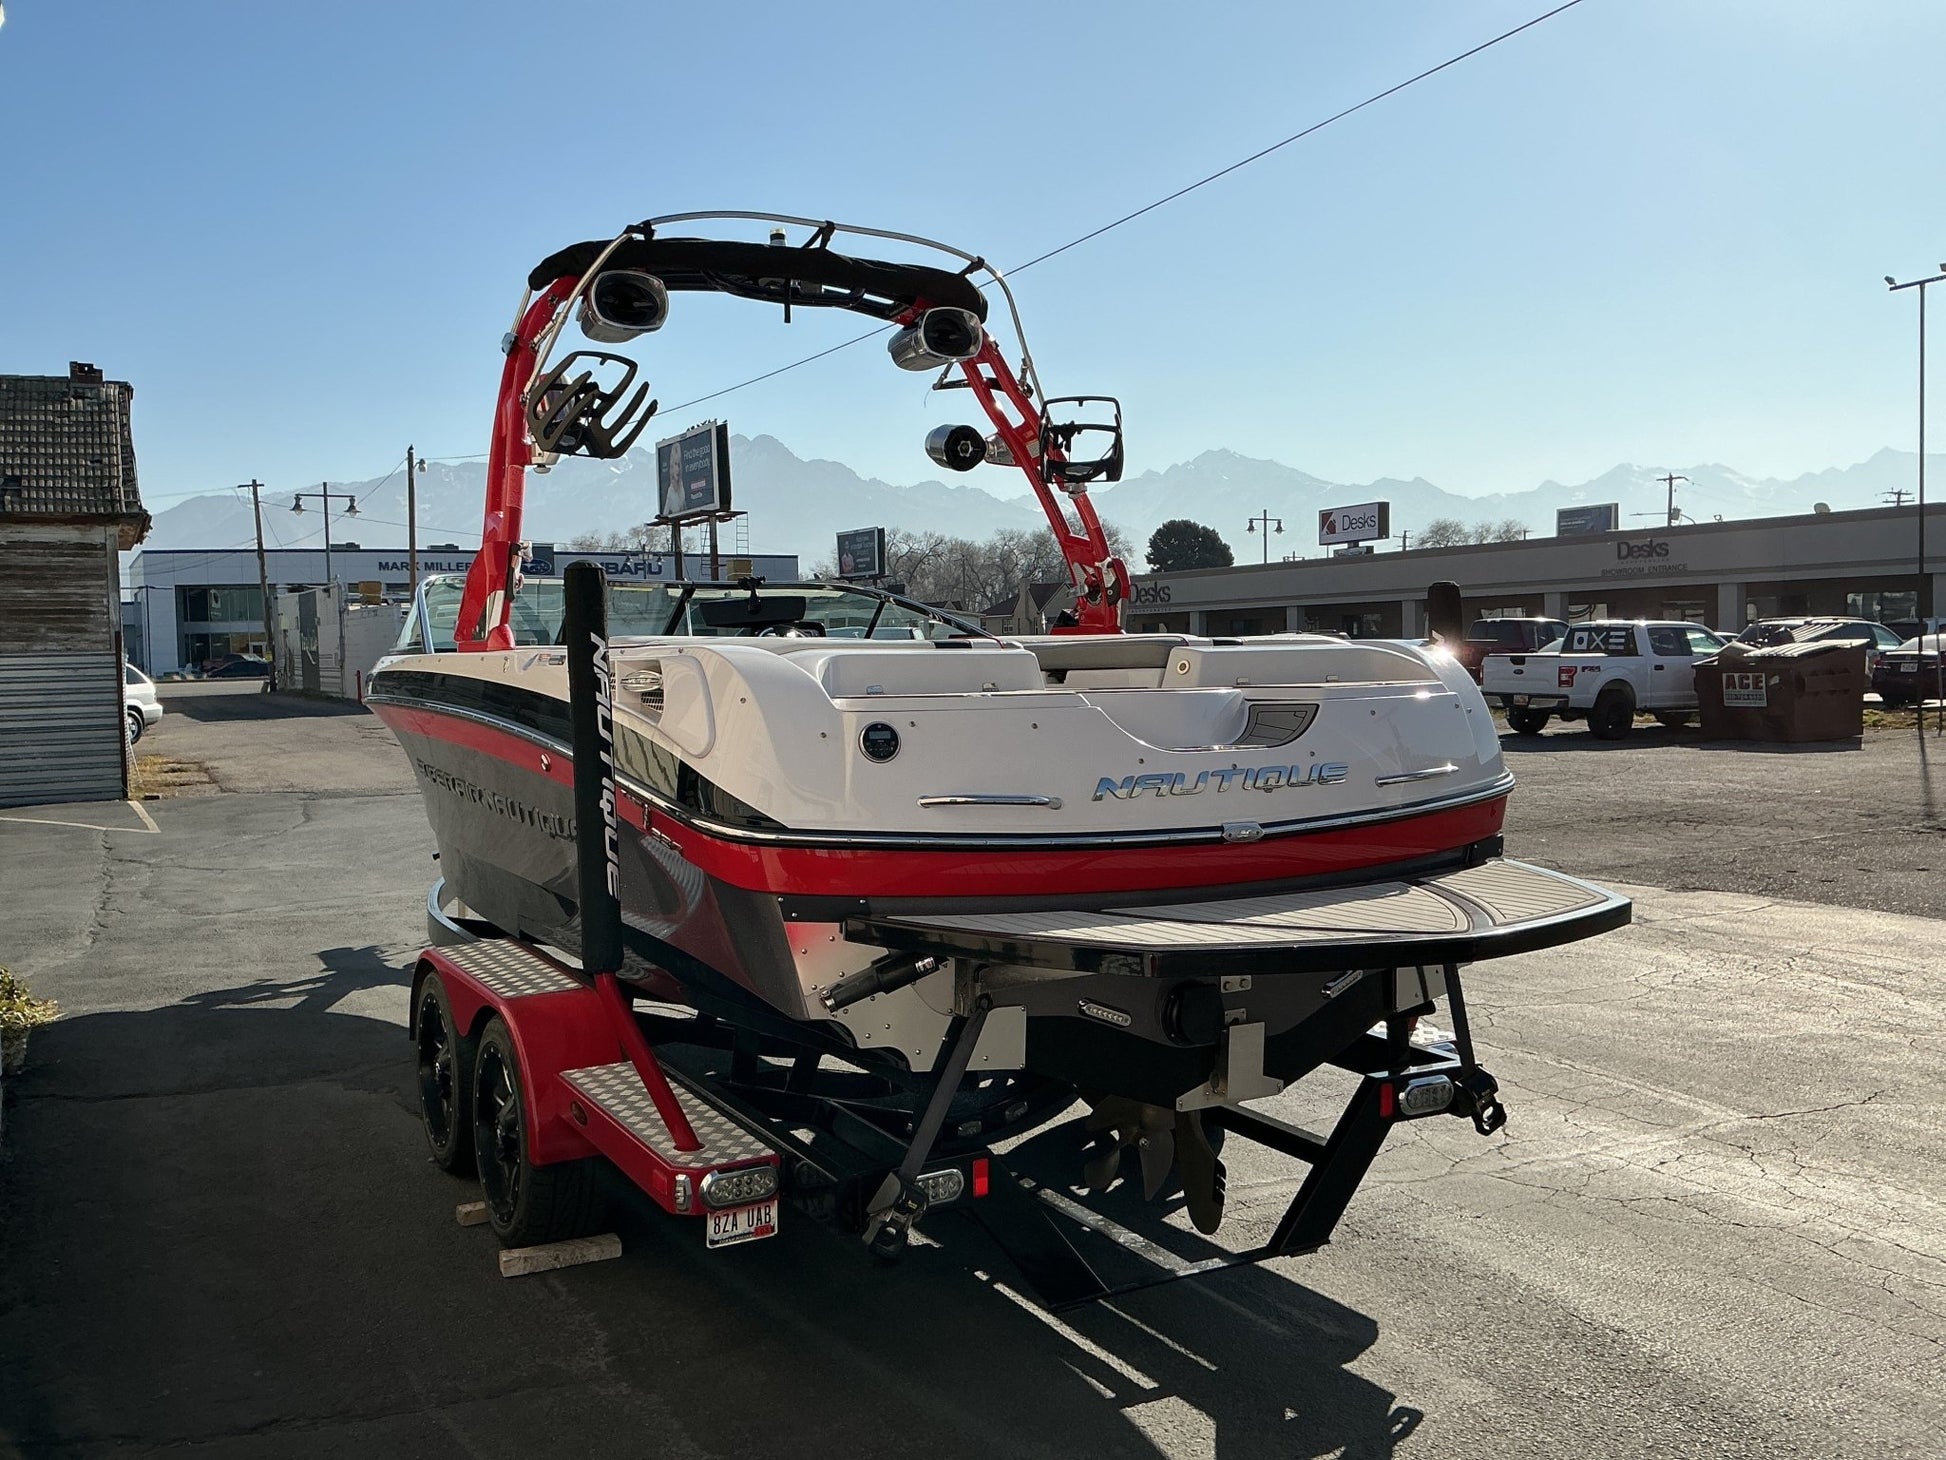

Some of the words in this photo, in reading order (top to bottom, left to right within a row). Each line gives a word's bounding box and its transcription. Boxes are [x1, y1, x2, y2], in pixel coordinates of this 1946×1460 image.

[1342, 512, 1377, 532] Desks
[1616, 539, 1669, 560] Desks
[1601, 566, 1645, 578] SHOWROOM
[1648, 563, 1688, 575] ENTRANCE
[1725, 674, 1763, 690] ACE
[590, 632, 620, 900] NAUTIQUE
[1092, 762, 1349, 801] NAUTIQUE
[713, 1212, 738, 1235] 8ZA
[747, 1205, 771, 1227] UAB
